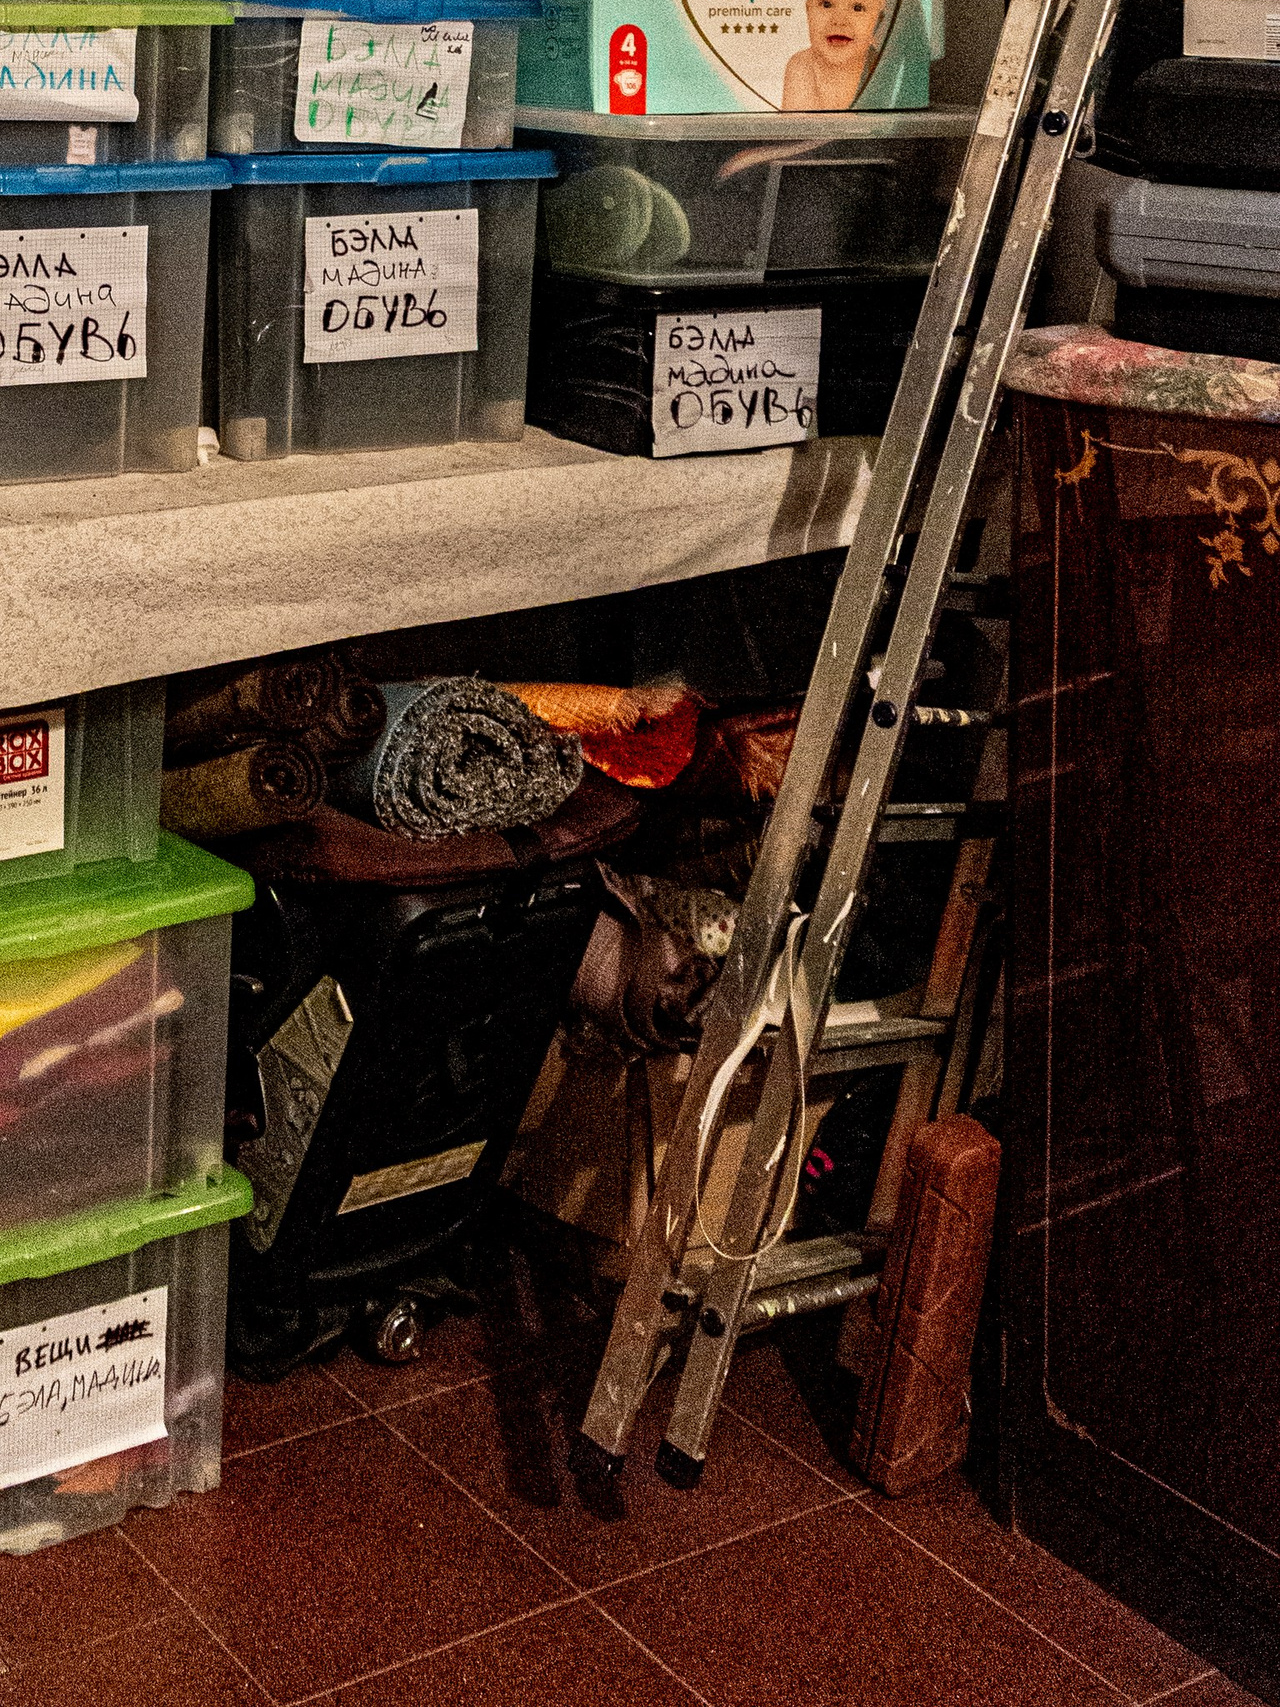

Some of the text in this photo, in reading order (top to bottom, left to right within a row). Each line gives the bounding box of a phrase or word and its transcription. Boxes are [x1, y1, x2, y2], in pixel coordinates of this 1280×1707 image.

[708, 5, 792, 18] premium care
[621, 32, 636, 57] 4
[331, 225, 418, 257] БЭЛЛА
[322, 289, 447, 333] ОБУВЬ
[670, 386, 813, 429] ОБУВЬ
[31, 784, 41, 795] 36
[15, 1335, 91, 1378] ВЕЩИ
